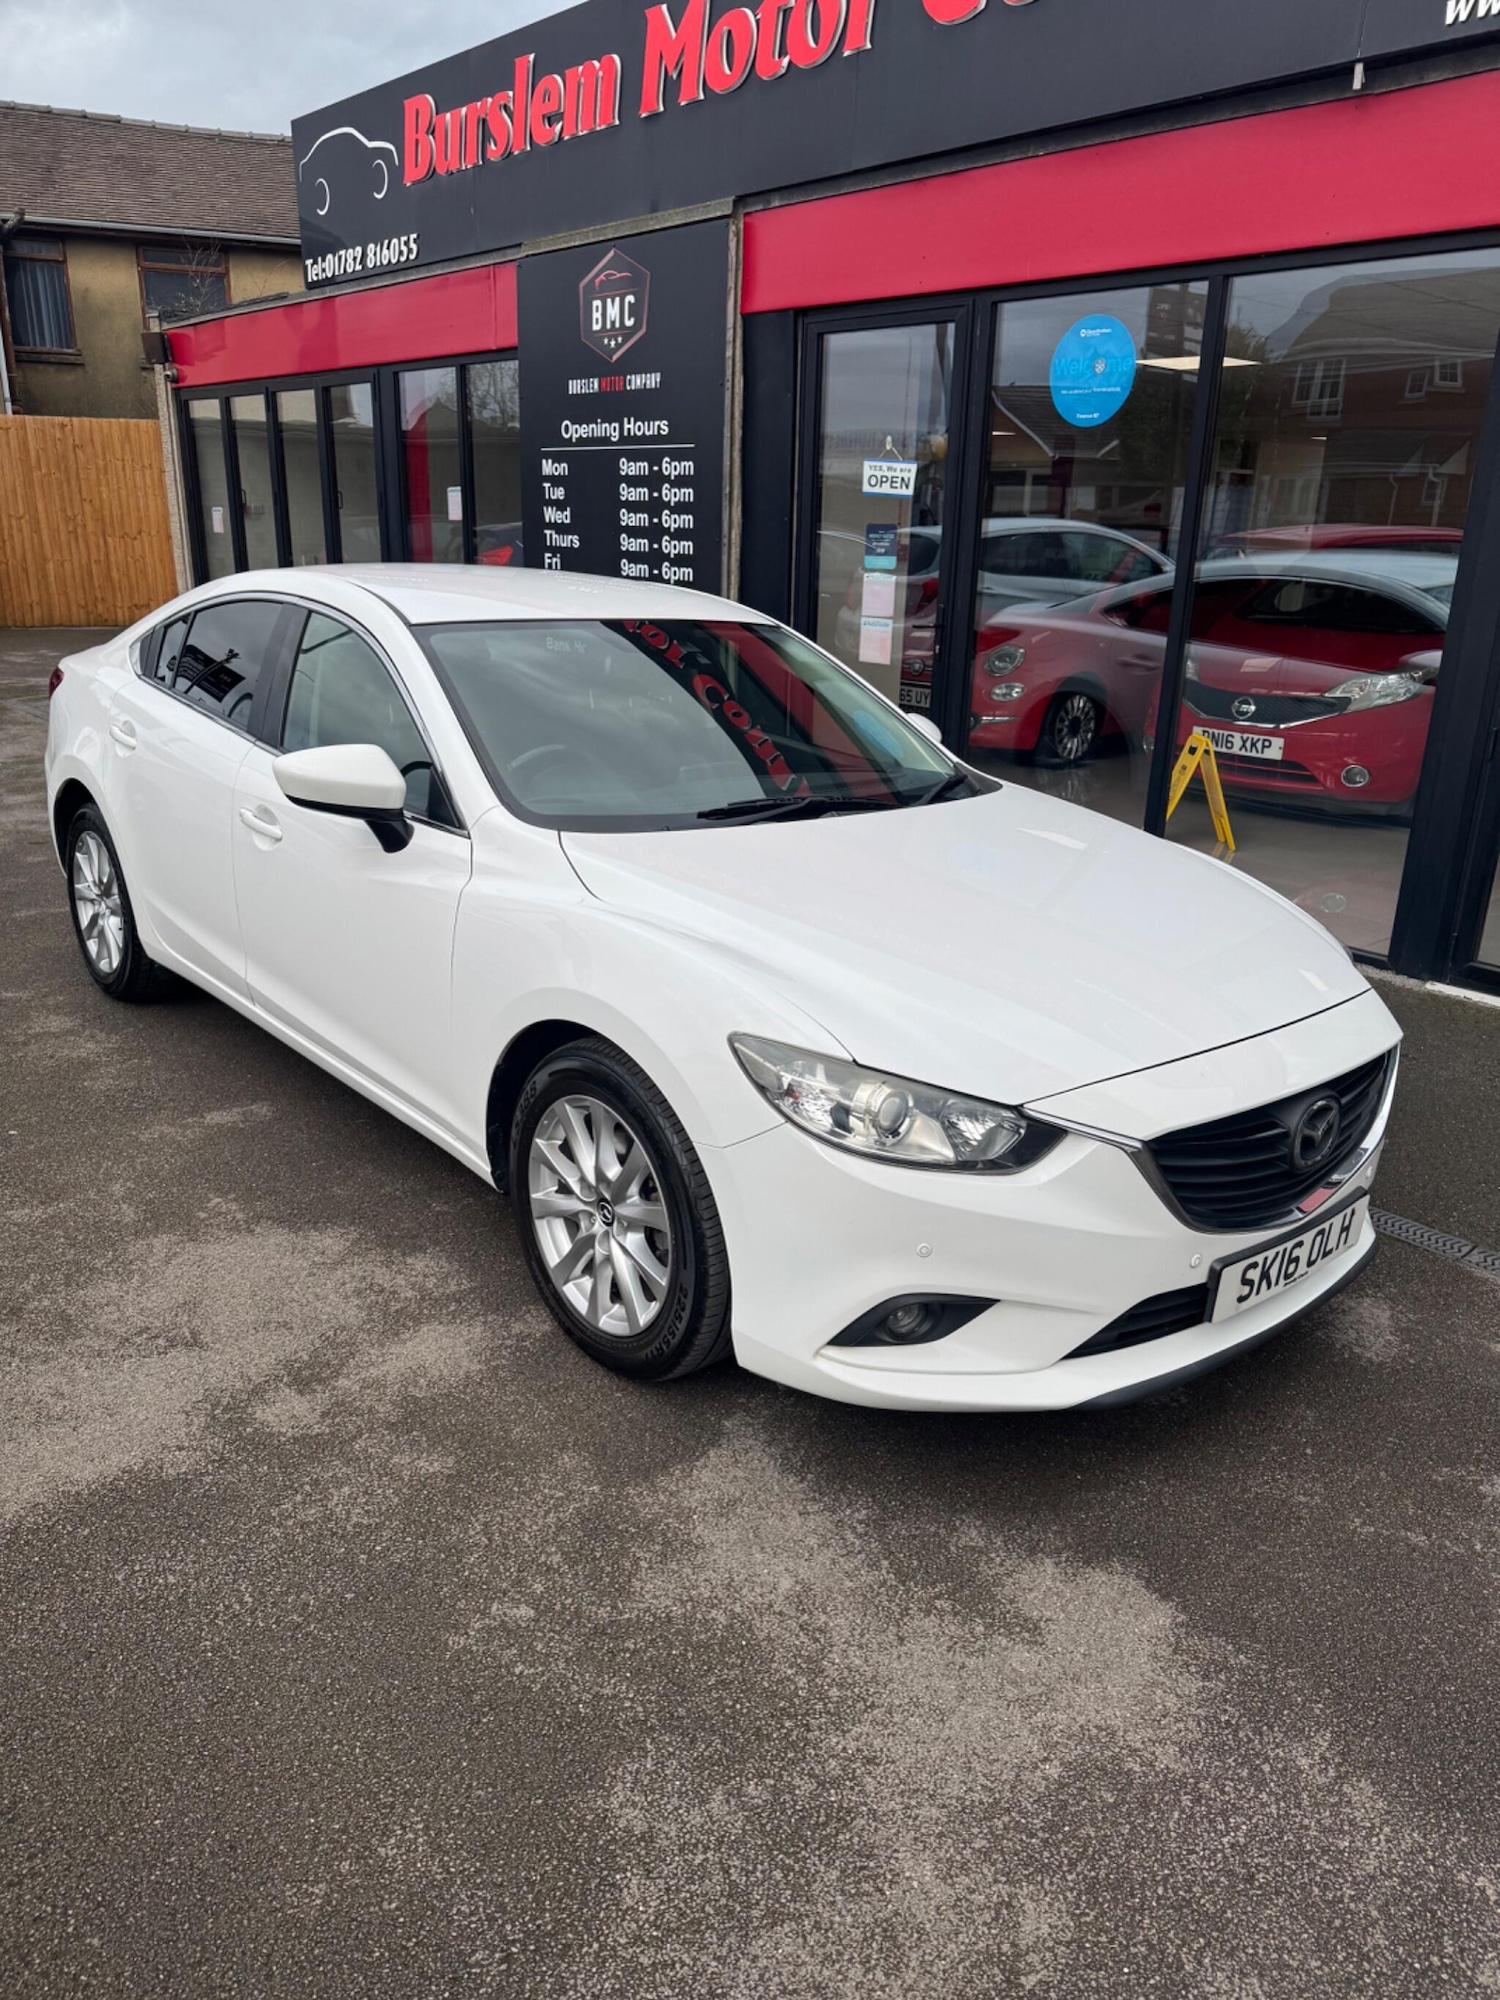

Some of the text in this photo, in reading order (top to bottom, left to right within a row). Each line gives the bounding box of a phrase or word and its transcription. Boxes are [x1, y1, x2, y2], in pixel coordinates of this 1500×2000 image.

[403, 53, 622, 187] Burslem
[305, 233, 418, 282] Tel:01782 816055
[592, 294, 636, 331] BMC
[626, 372, 660, 391] COMPANY
[561, 417, 669, 442] Opening Hours
[542, 459, 568, 476] Mon
[619, 458, 649, 476] 9am
[662, 457, 695, 480] 6pm
[543, 483, 565, 500] Tue
[619, 483, 649, 502] 9am
[662, 483, 694, 506] 6pm
[867, 474, 911, 490] OPEN
[543, 506, 571, 524] Wed
[619, 508, 649, 527] 9am
[662, 509, 694, 532] 6pm
[544, 530, 580, 548] Thurs
[620, 534, 649, 552] 9am
[662, 535, 694, 558] 6pm
[544, 553, 561, 570] Fri
[620, 559, 649, 577] 9am
[662, 562, 693, 584] 6pm
[1239, 735, 1272, 754] XKP
[1236, 1207, 1356, 1304] SK16 OLH
